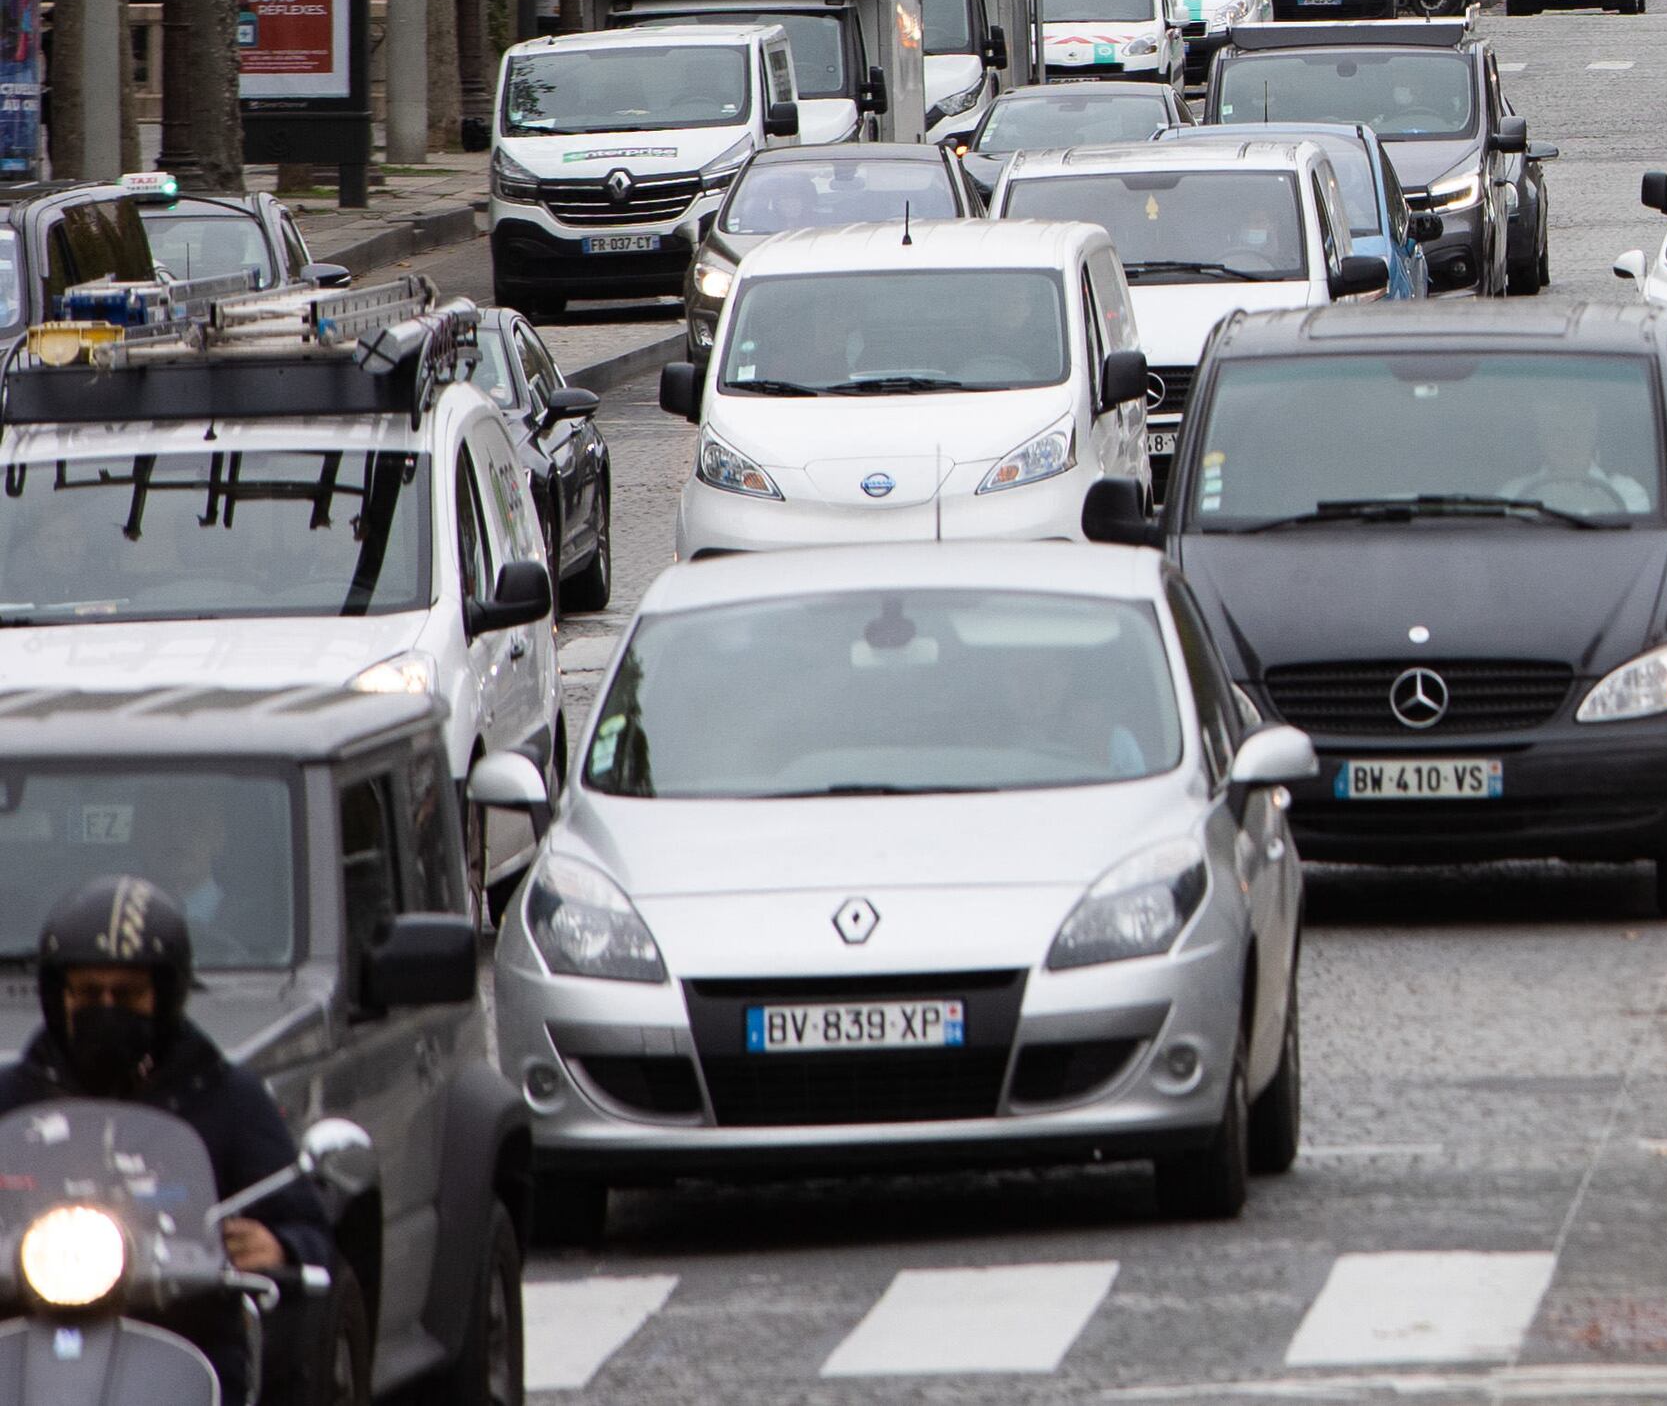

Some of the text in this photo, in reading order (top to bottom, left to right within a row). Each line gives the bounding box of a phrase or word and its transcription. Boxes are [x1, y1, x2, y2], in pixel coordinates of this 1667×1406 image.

[258, 2, 328, 15] RÉFLEXES.
[565, 148, 678, 162] enterprise
[590, 235, 652, 251] FR-037-CY
[1354, 764, 1483, 794] BW-410-VS
[767, 1005, 941, 1044] BV-839-XP
